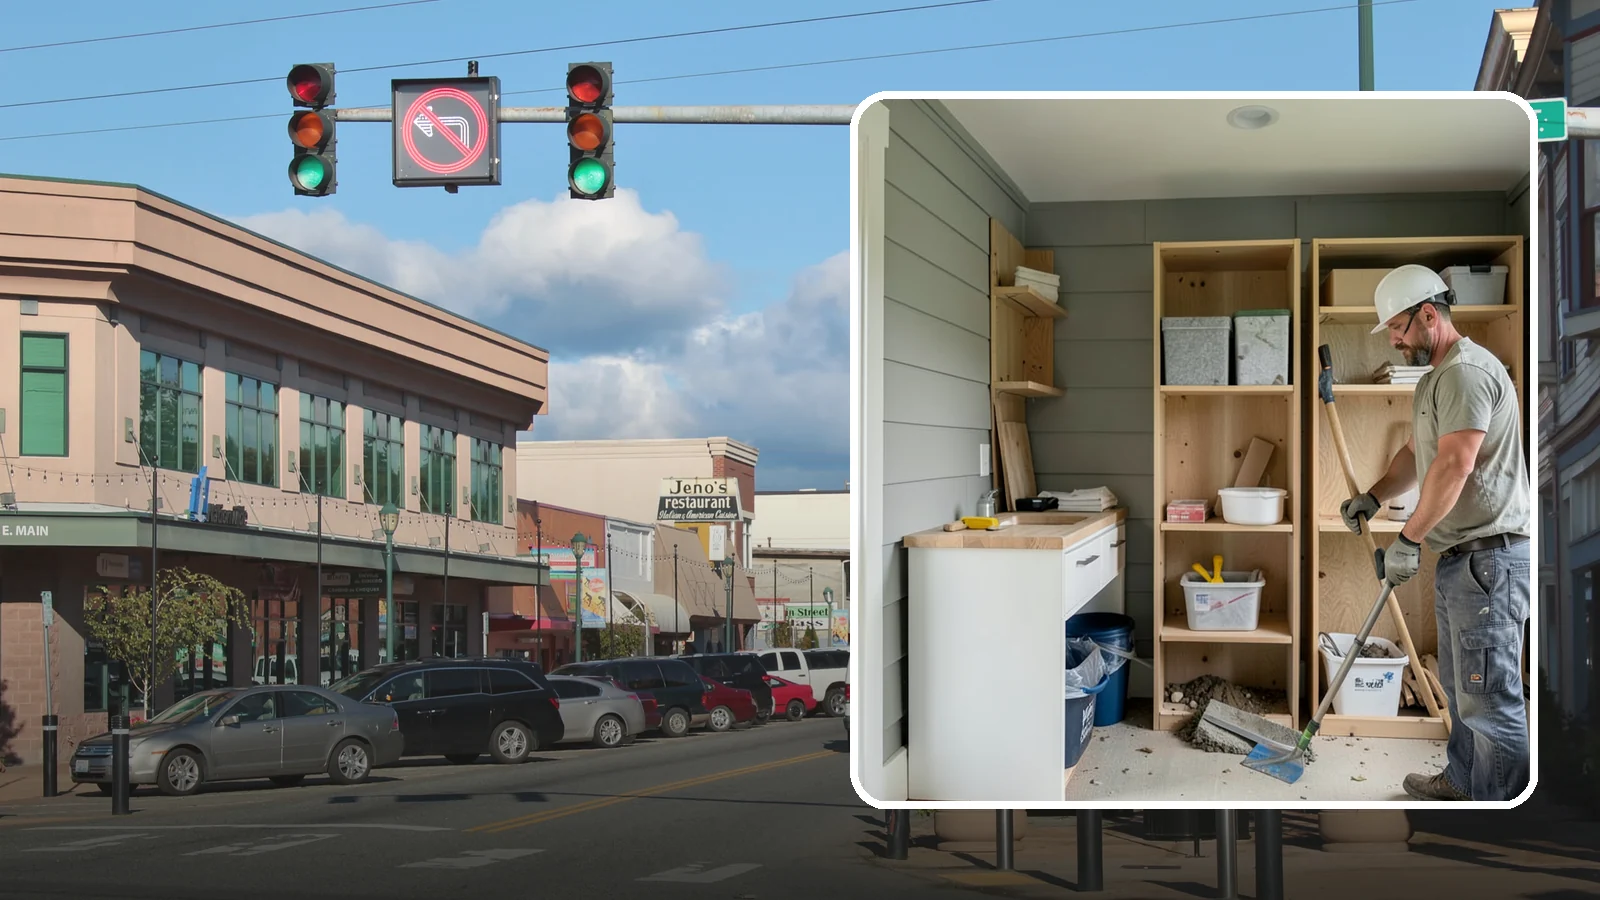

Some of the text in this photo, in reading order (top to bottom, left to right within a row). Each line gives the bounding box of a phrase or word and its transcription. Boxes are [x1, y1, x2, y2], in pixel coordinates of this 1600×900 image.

[670, 480, 727, 494] Jeno's
[665, 496, 731, 509] restaurant
[659, 510, 681, 520] Italian
[686, 510, 714, 519] American
[715, 509, 737, 519] Cuisine
[2, 525, 49, 536] E. MAIN
[797, 608, 828, 617] Street
